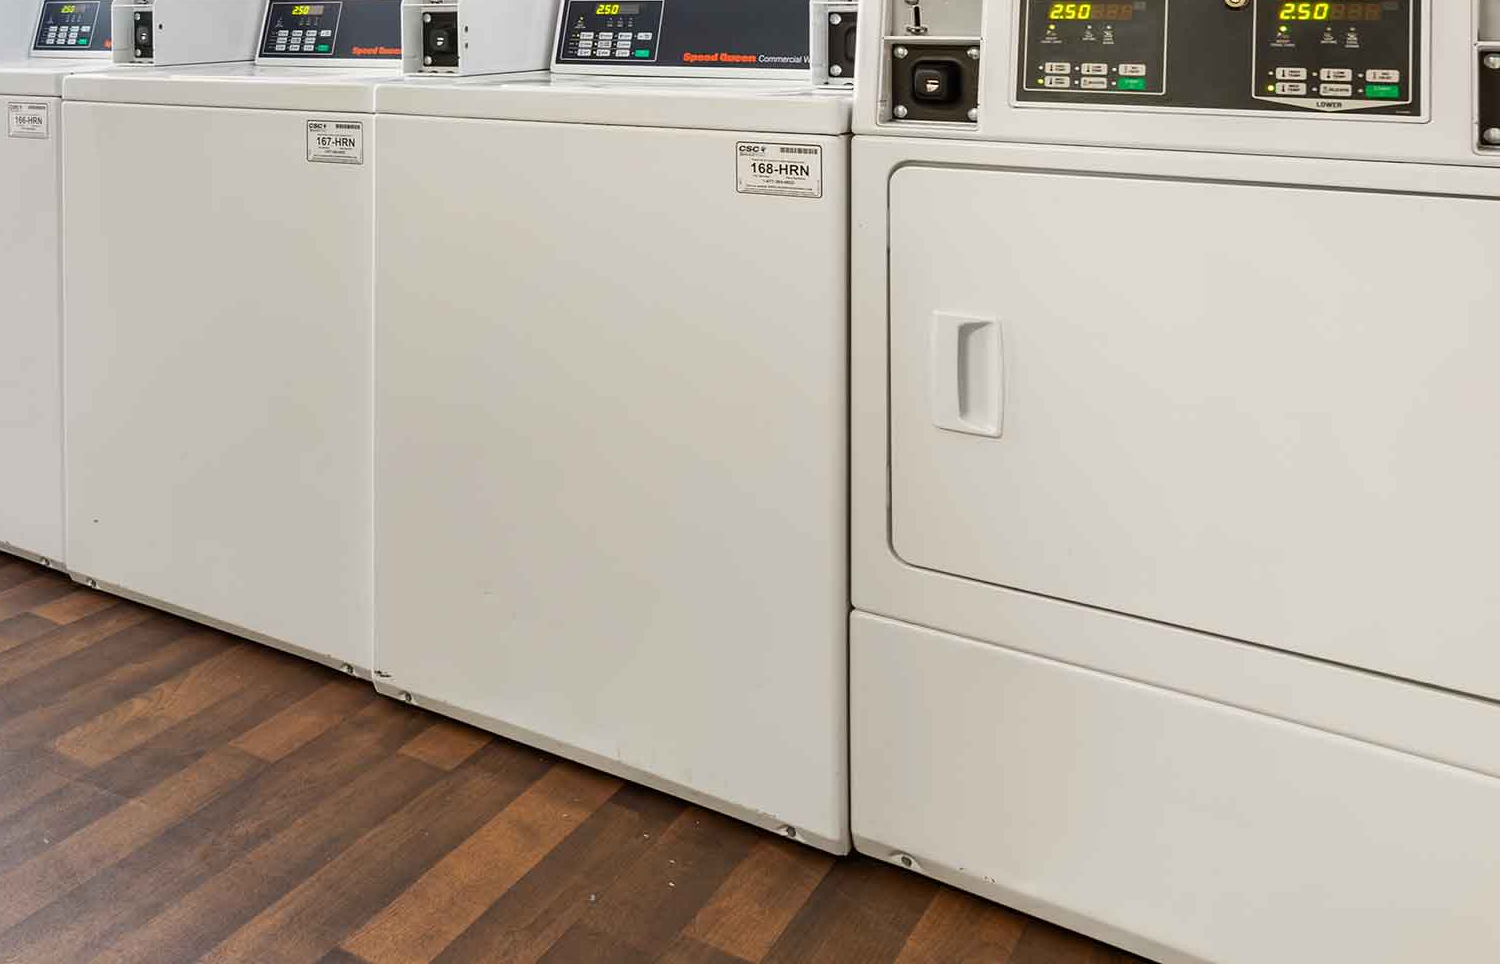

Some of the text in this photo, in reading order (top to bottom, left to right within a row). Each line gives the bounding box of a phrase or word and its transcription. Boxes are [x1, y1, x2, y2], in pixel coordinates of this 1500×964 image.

[1049, 3, 1092, 20] 2.50
[1278, 2, 1330, 21] 2.50
[683, 52, 718, 62] Speed
[719, 53, 757, 62] Queen
[758, 54, 802, 63] Commercial
[1316, 101, 1343, 109] LOWER
[316, 136, 356, 148] 167-HRN
[738, 145, 760, 153] CSC
[750, 162, 810, 177] 168-HRN
